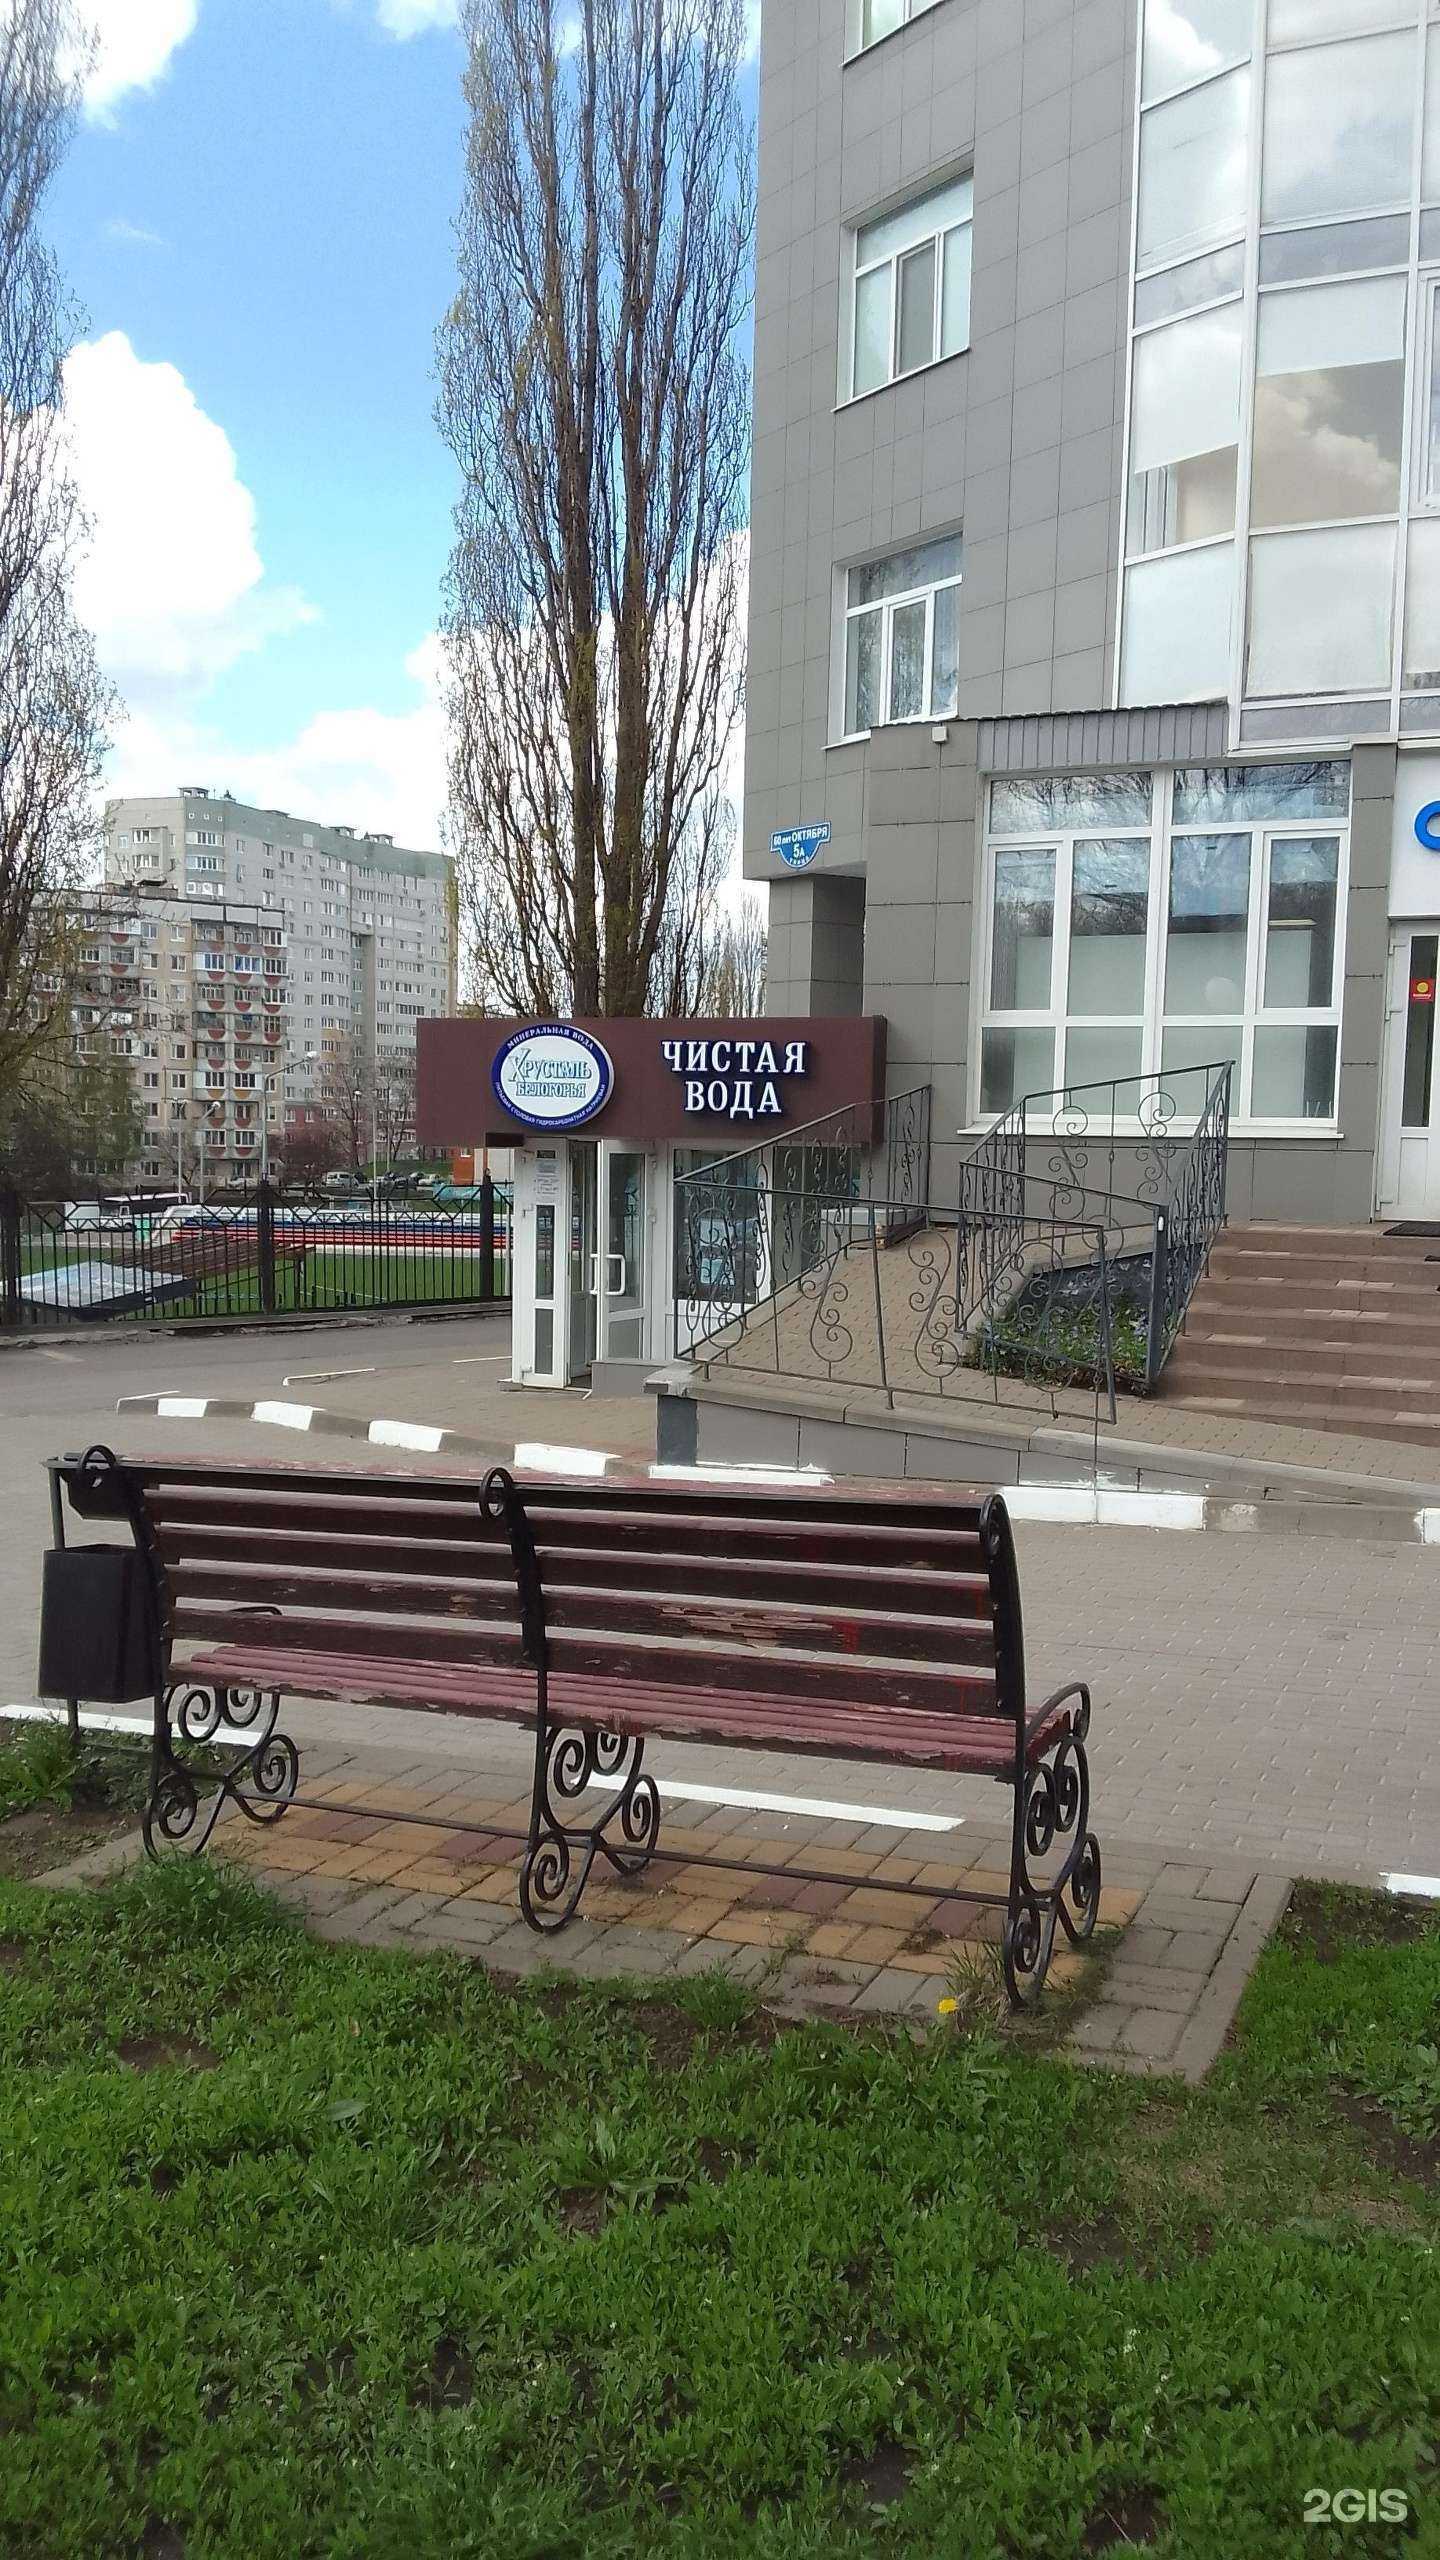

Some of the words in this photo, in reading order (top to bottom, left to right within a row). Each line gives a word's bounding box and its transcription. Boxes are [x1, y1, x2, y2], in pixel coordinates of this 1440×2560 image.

[792, 826, 828, 843] ОКТЯБРЯ
[507, 1026, 570, 1049] МИНЕРАЛЬНАЯ
[572, 1031, 594, 1050] ВОДА
[662, 1040, 806, 1073] ЧИСТАЯ
[516, 1082, 587, 1098] БЕЛОГОРЬЯ
[685, 1080, 782, 1119] ВОДА
